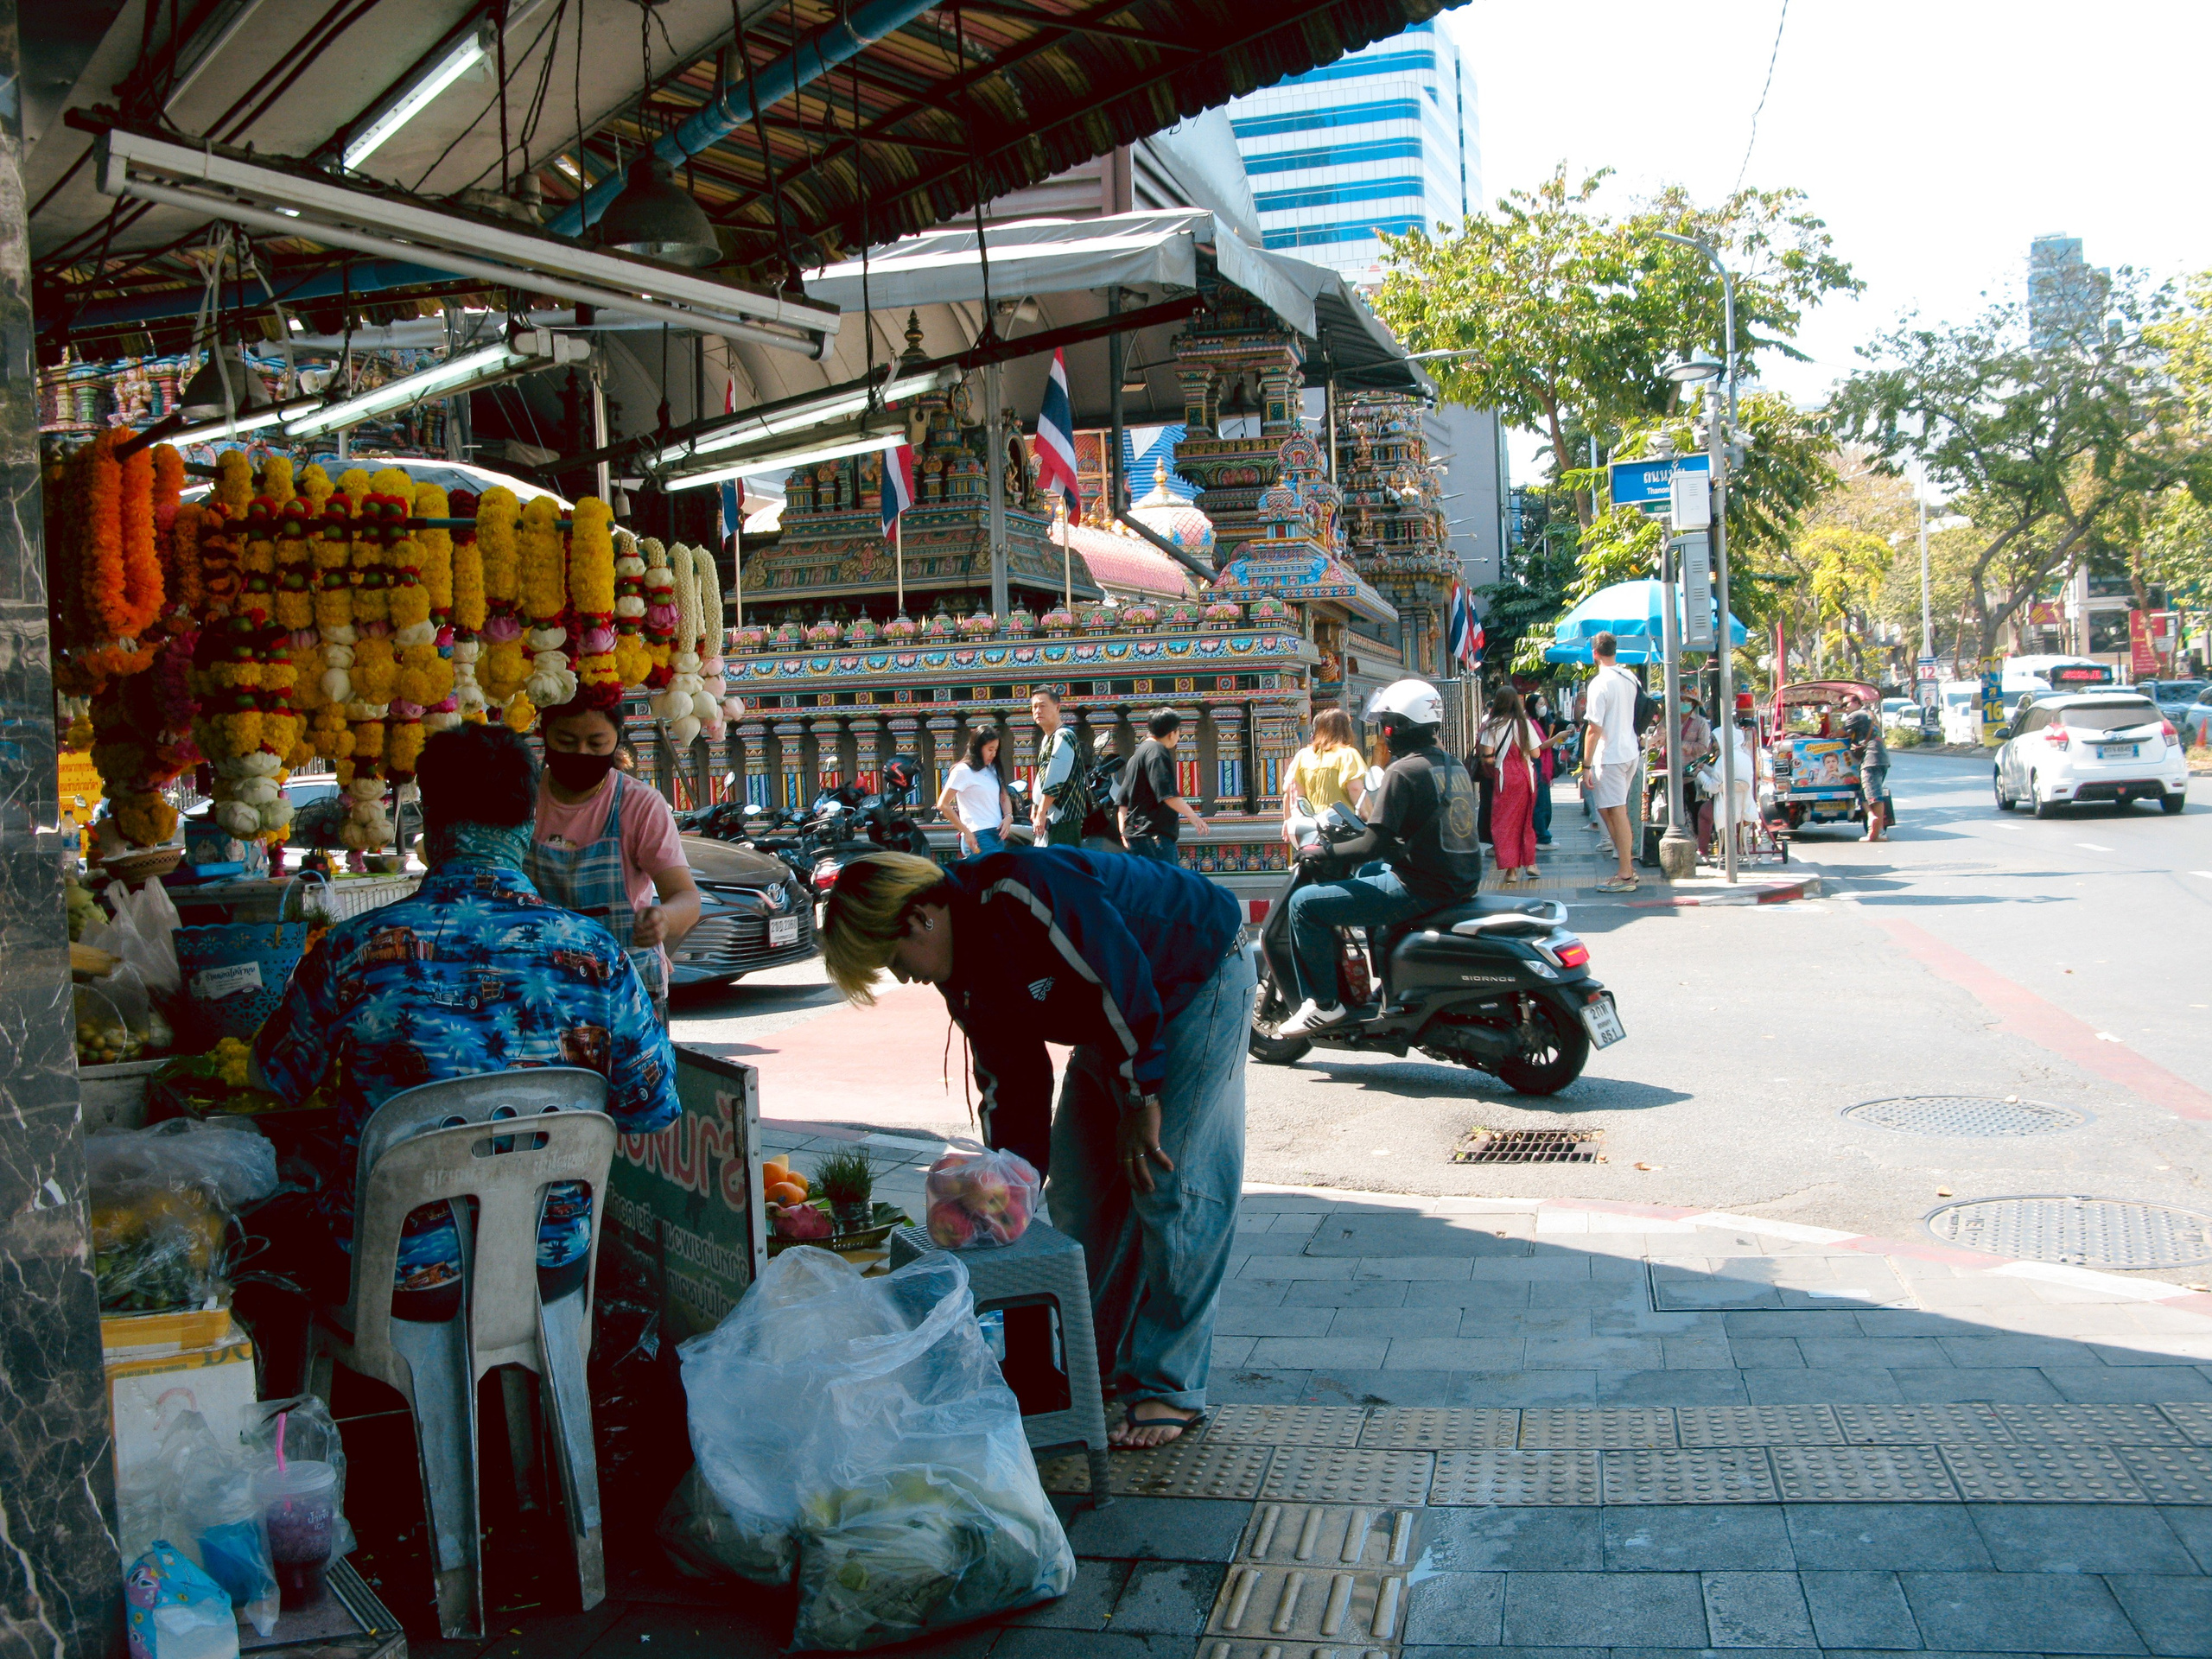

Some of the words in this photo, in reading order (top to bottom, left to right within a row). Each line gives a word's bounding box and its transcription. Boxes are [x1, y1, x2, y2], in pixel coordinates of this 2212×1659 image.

[1646, 486, 1670, 495] Thanon
[1920, 666, 1936, 678] 12
[1983, 700, 2004, 721] 16
[1037, 976, 1057, 1002] SPORT
[1600, 1027, 1618, 1044] 851
[314, 1522, 325, 1530] ICE
